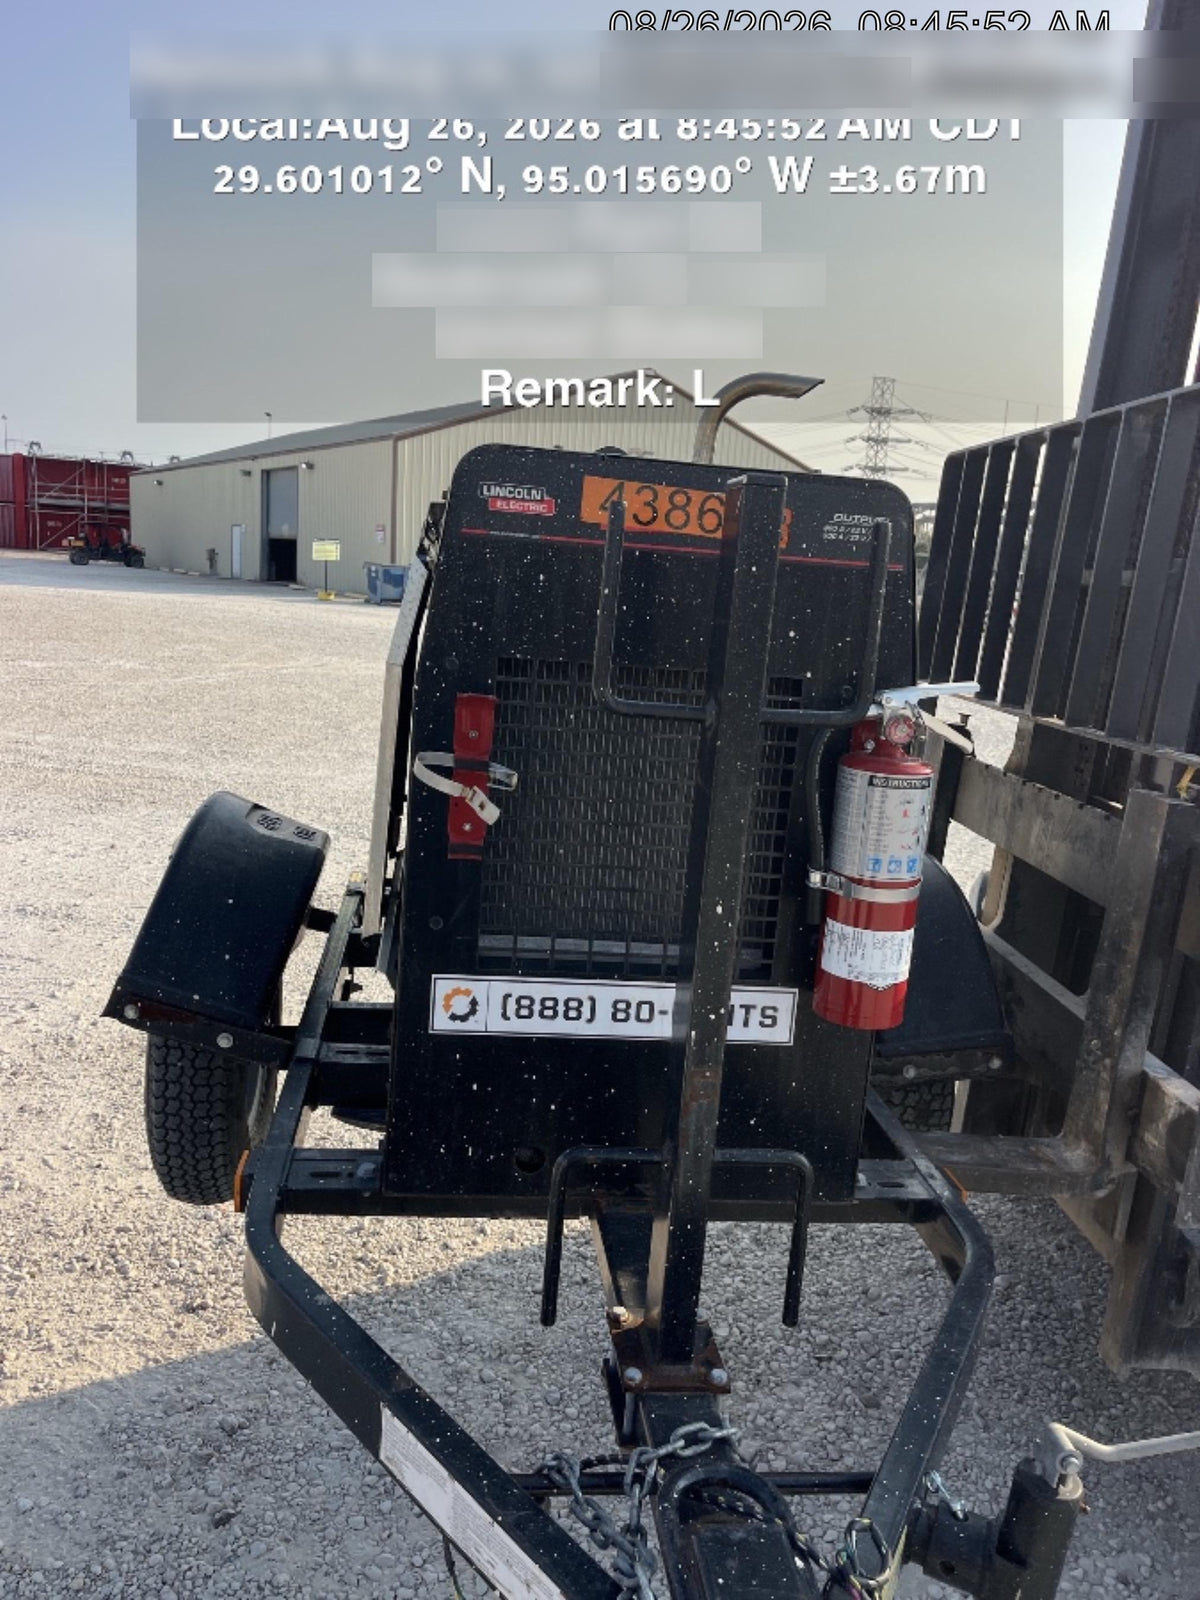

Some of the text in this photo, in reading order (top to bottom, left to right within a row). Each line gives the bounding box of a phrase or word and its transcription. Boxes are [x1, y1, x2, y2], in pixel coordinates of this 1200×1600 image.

[482, 484, 542, 500] LINCOLN
[496, 500, 549, 512] ELECTRIC
[500, 993, 597, 1024] (888)
